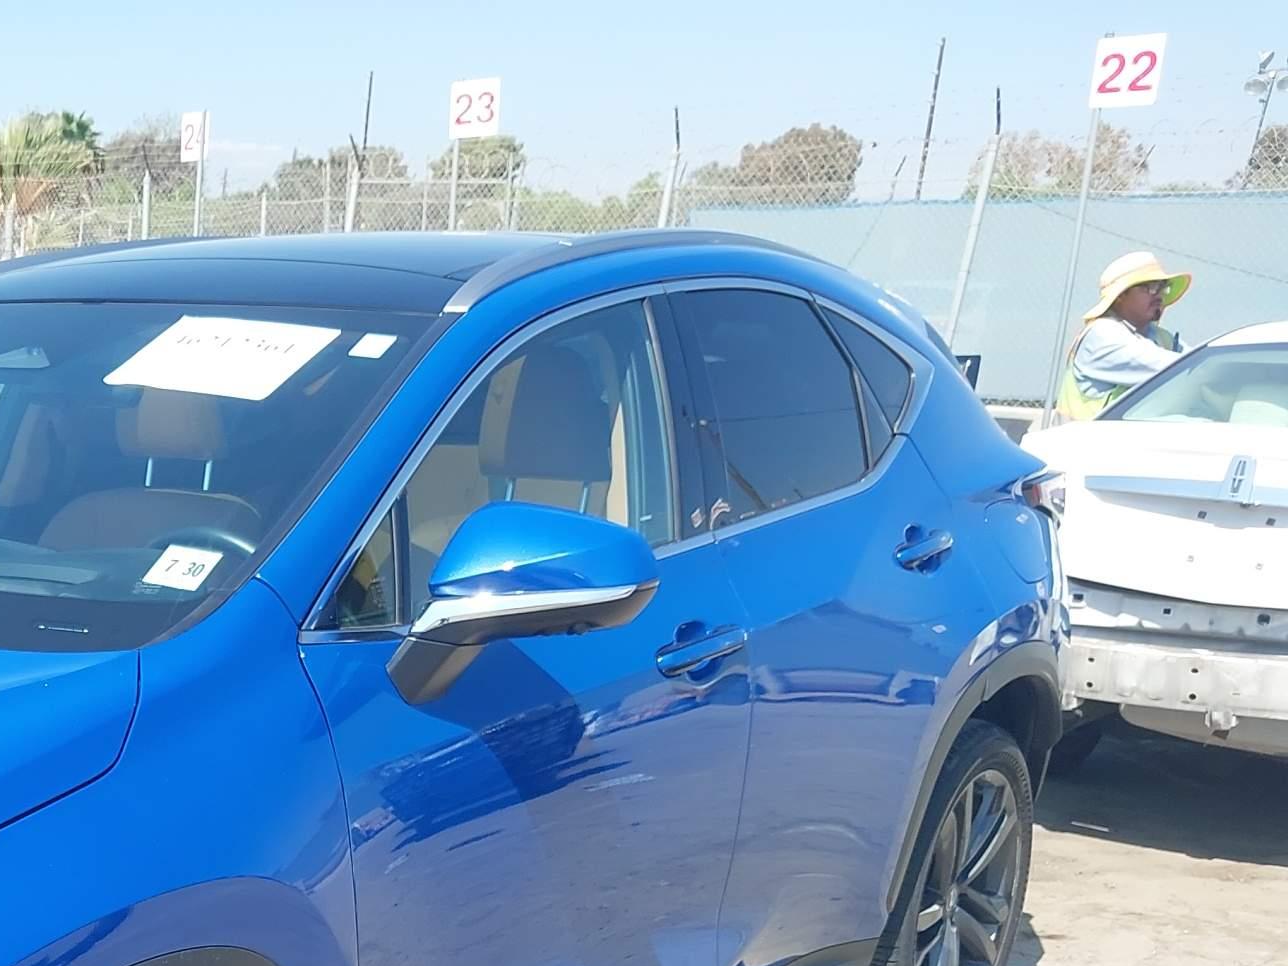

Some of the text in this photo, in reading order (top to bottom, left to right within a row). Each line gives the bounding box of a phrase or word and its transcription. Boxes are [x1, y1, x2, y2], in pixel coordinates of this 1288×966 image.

[1097, 50, 1157, 93] 22
[455, 92, 494, 125] 23
[165, 559, 205, 577] 7 30
